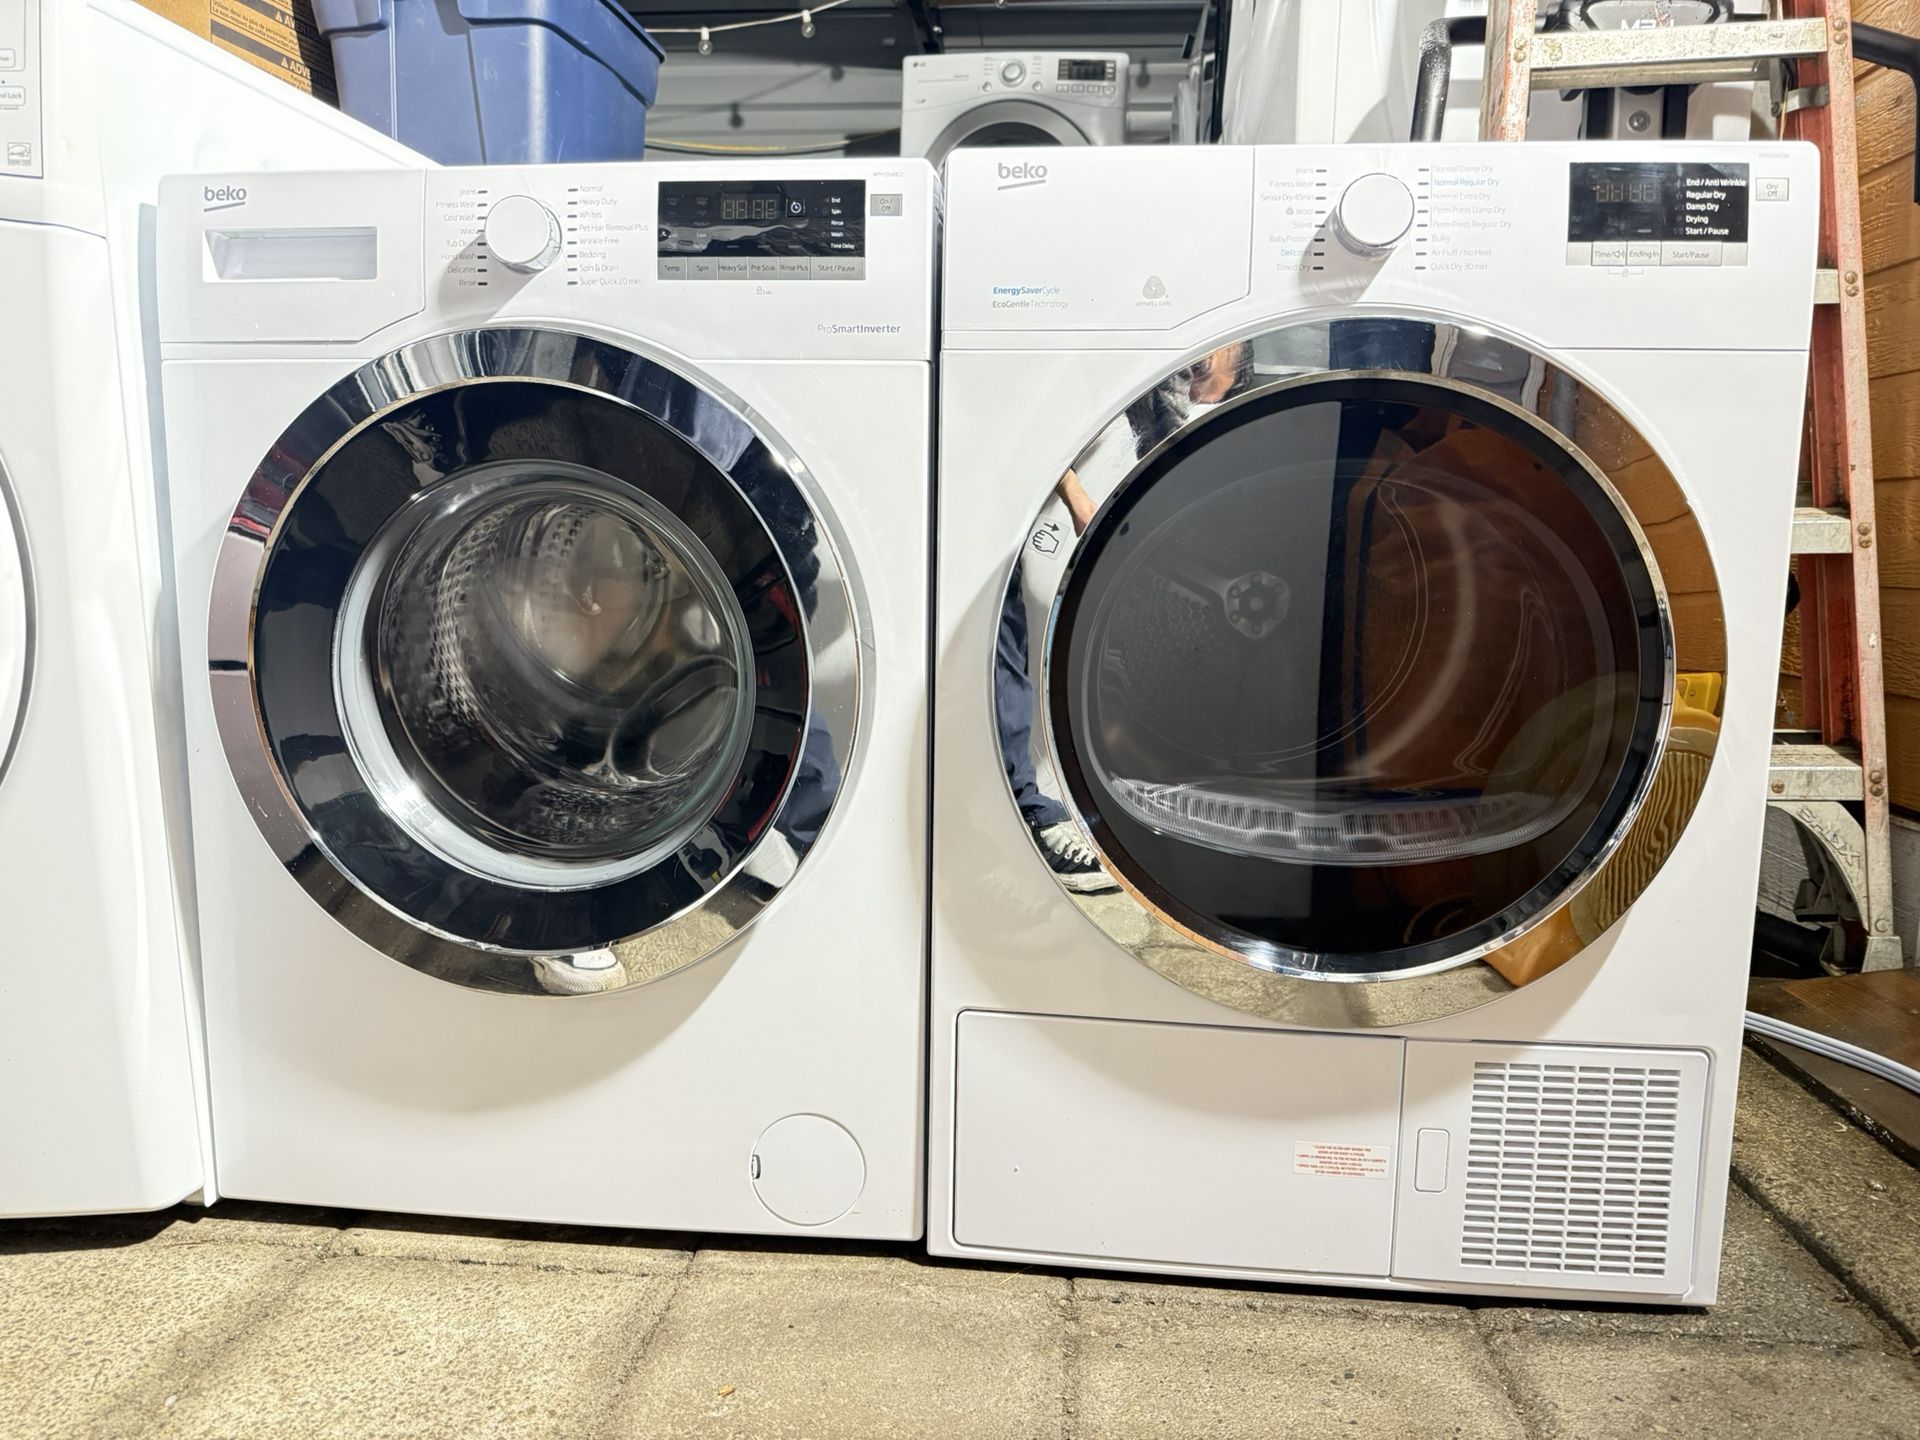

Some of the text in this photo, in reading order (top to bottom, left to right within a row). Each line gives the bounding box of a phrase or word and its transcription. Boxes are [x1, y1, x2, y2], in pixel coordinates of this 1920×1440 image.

[998, 162, 1048, 179] beko
[1481, 165, 1493, 173] Dry
[1487, 178, 1499, 186] Dry
[204, 185, 247, 201] beko
[1479, 193, 1490, 201] Dry
[1686, 192, 1726, 200] Regular Dry
[580, 198, 617, 206] Heavy Duty
[1494, 207, 1506, 215] Dry
[1686, 203, 1719, 212] Damp Dry
[1686, 216, 1709, 224] Drying
[579, 224, 590, 232] Pet
[1472, 221, 1498, 229] Regular
[1500, 221, 1512, 229] Dry
[579, 237, 603, 245] Wrinkle
[579, 251, 606, 259] Bedding
[1629, 250, 1651, 259] Ending
[601, 264, 619, 272] Drain
[1299, 264, 1311, 272] Dry
[1430, 263, 1449, 271] Quick
[1450, 263, 1463, 271] Dry
[993, 287, 1060, 296] EnergySaverCycle
[818, 324, 901, 333] ProSmartInverter
